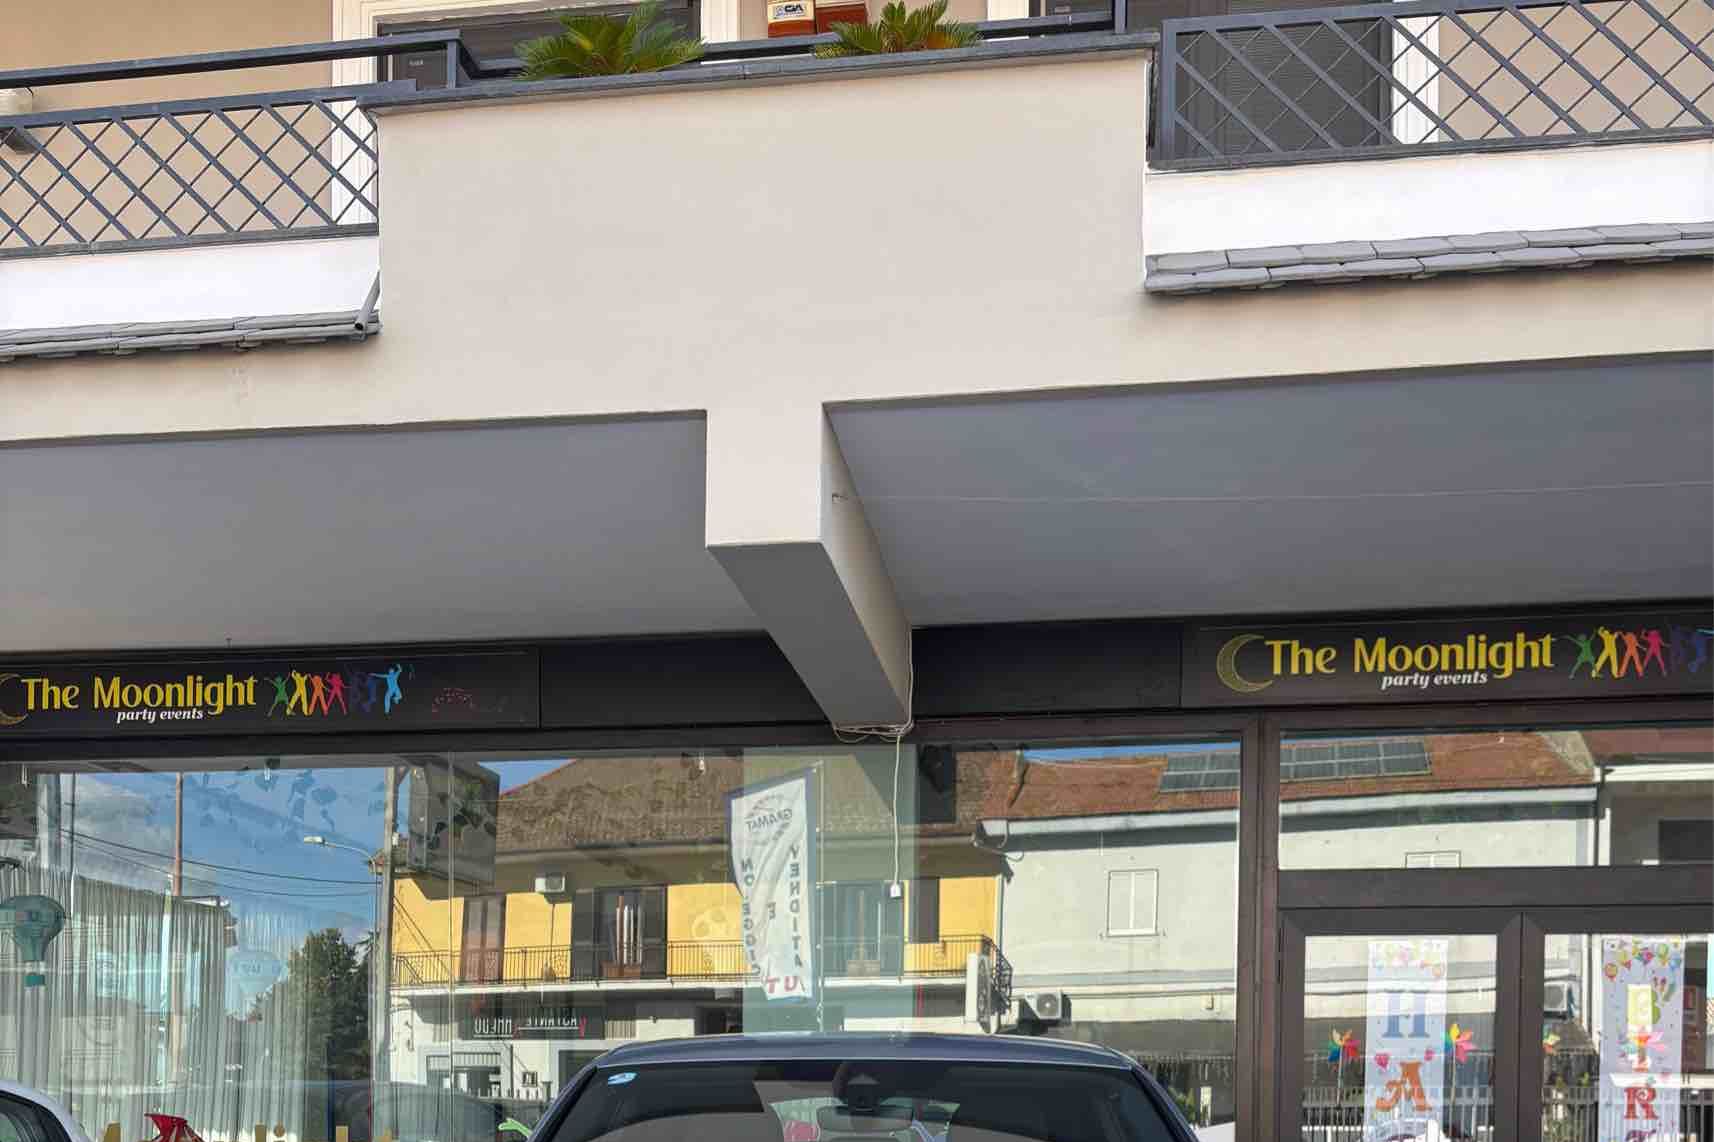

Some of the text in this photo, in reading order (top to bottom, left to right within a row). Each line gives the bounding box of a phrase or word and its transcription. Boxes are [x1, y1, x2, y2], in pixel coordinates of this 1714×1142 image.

[1264, 632, 1554, 679] The Moonlight
[20, 674, 258, 715] The Moonlight
[1380, 669, 1489, 691] party events
[116, 707, 205, 724] party events
